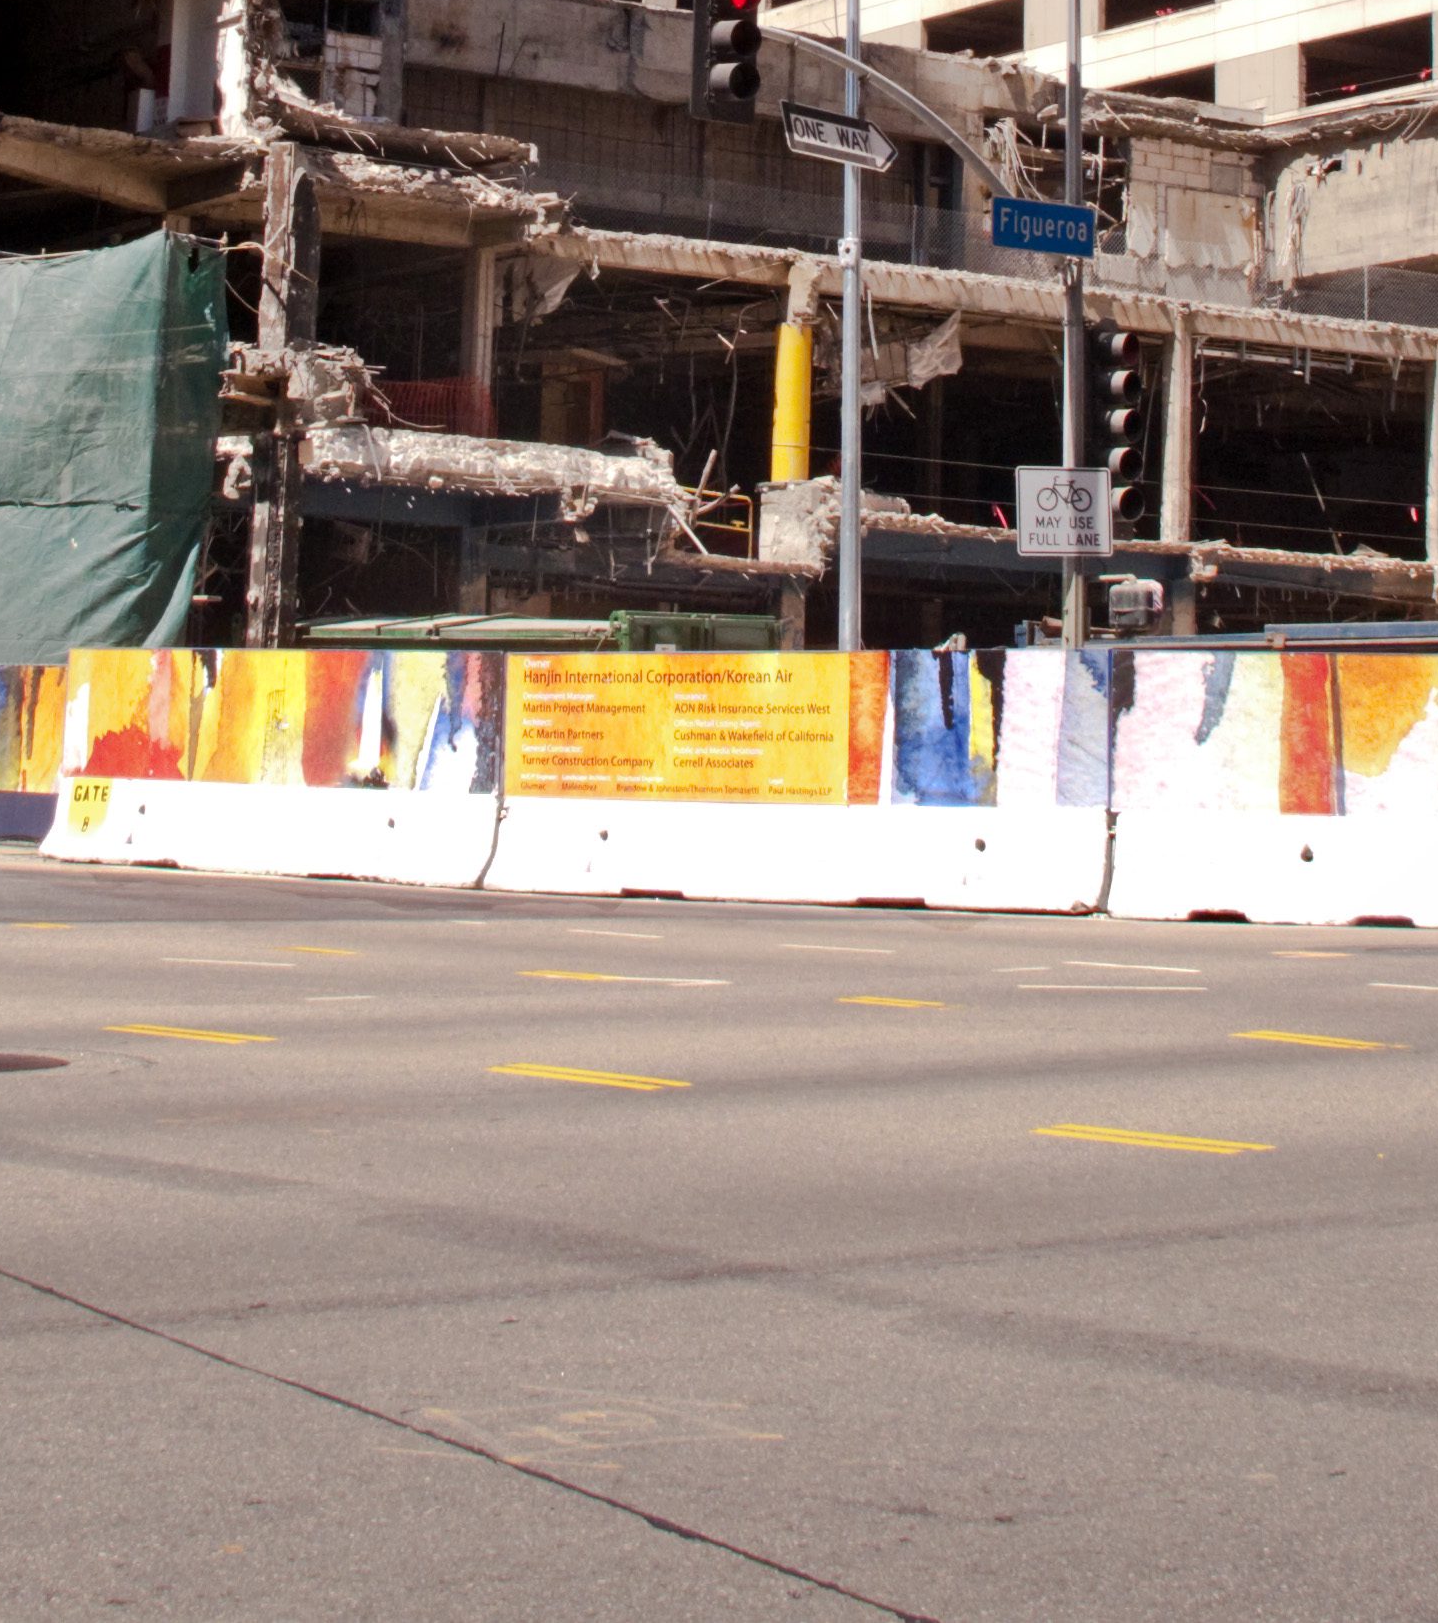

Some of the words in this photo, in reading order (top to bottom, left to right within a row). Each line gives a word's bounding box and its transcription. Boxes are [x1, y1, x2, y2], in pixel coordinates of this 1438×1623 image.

[793, 117, 827, 144] ONE
[835, 126, 870, 153] WAY
[1000, 207, 1087, 243] Figueroa
[1035, 516, 1061, 528] MAY
[1069, 516, 1094, 529] USE
[1028, 532, 1060, 546] FULL
[1067, 533, 1101, 546] LANE
[523, 670, 562, 687] Hanjin
[565, 669, 643, 684] International
[646, 669, 771, 687] Corporation/Korean
[774, 669, 793, 683] Air
[523, 702, 552, 713] Martin
[553, 703, 584, 716] Project
[586, 703, 645, 716] Management
[674, 703, 696, 714] AON
[698, 703, 716, 714] Risk
[718, 704, 764, 714] Insurance
[766, 704, 805, 715] Services
[806, 704, 831, 715] West
[522, 728, 535, 739] AC
[536, 728, 565, 739] Martin
[567, 729, 605, 740] Partners
[674, 729, 717, 741] Cushman
[719, 730, 726, 741] &
[728, 730, 773, 742] Wakefield
[776, 730, 786, 742] of
[788, 730, 834, 742] California
[522, 755, 550, 766] Turner
[551, 756, 609, 767] Construction
[611, 756, 654, 768] Company
[673, 757, 703, 768] Cerrell
[705, 757, 754, 769] Associates
[73, 784, 110, 803] GATE
